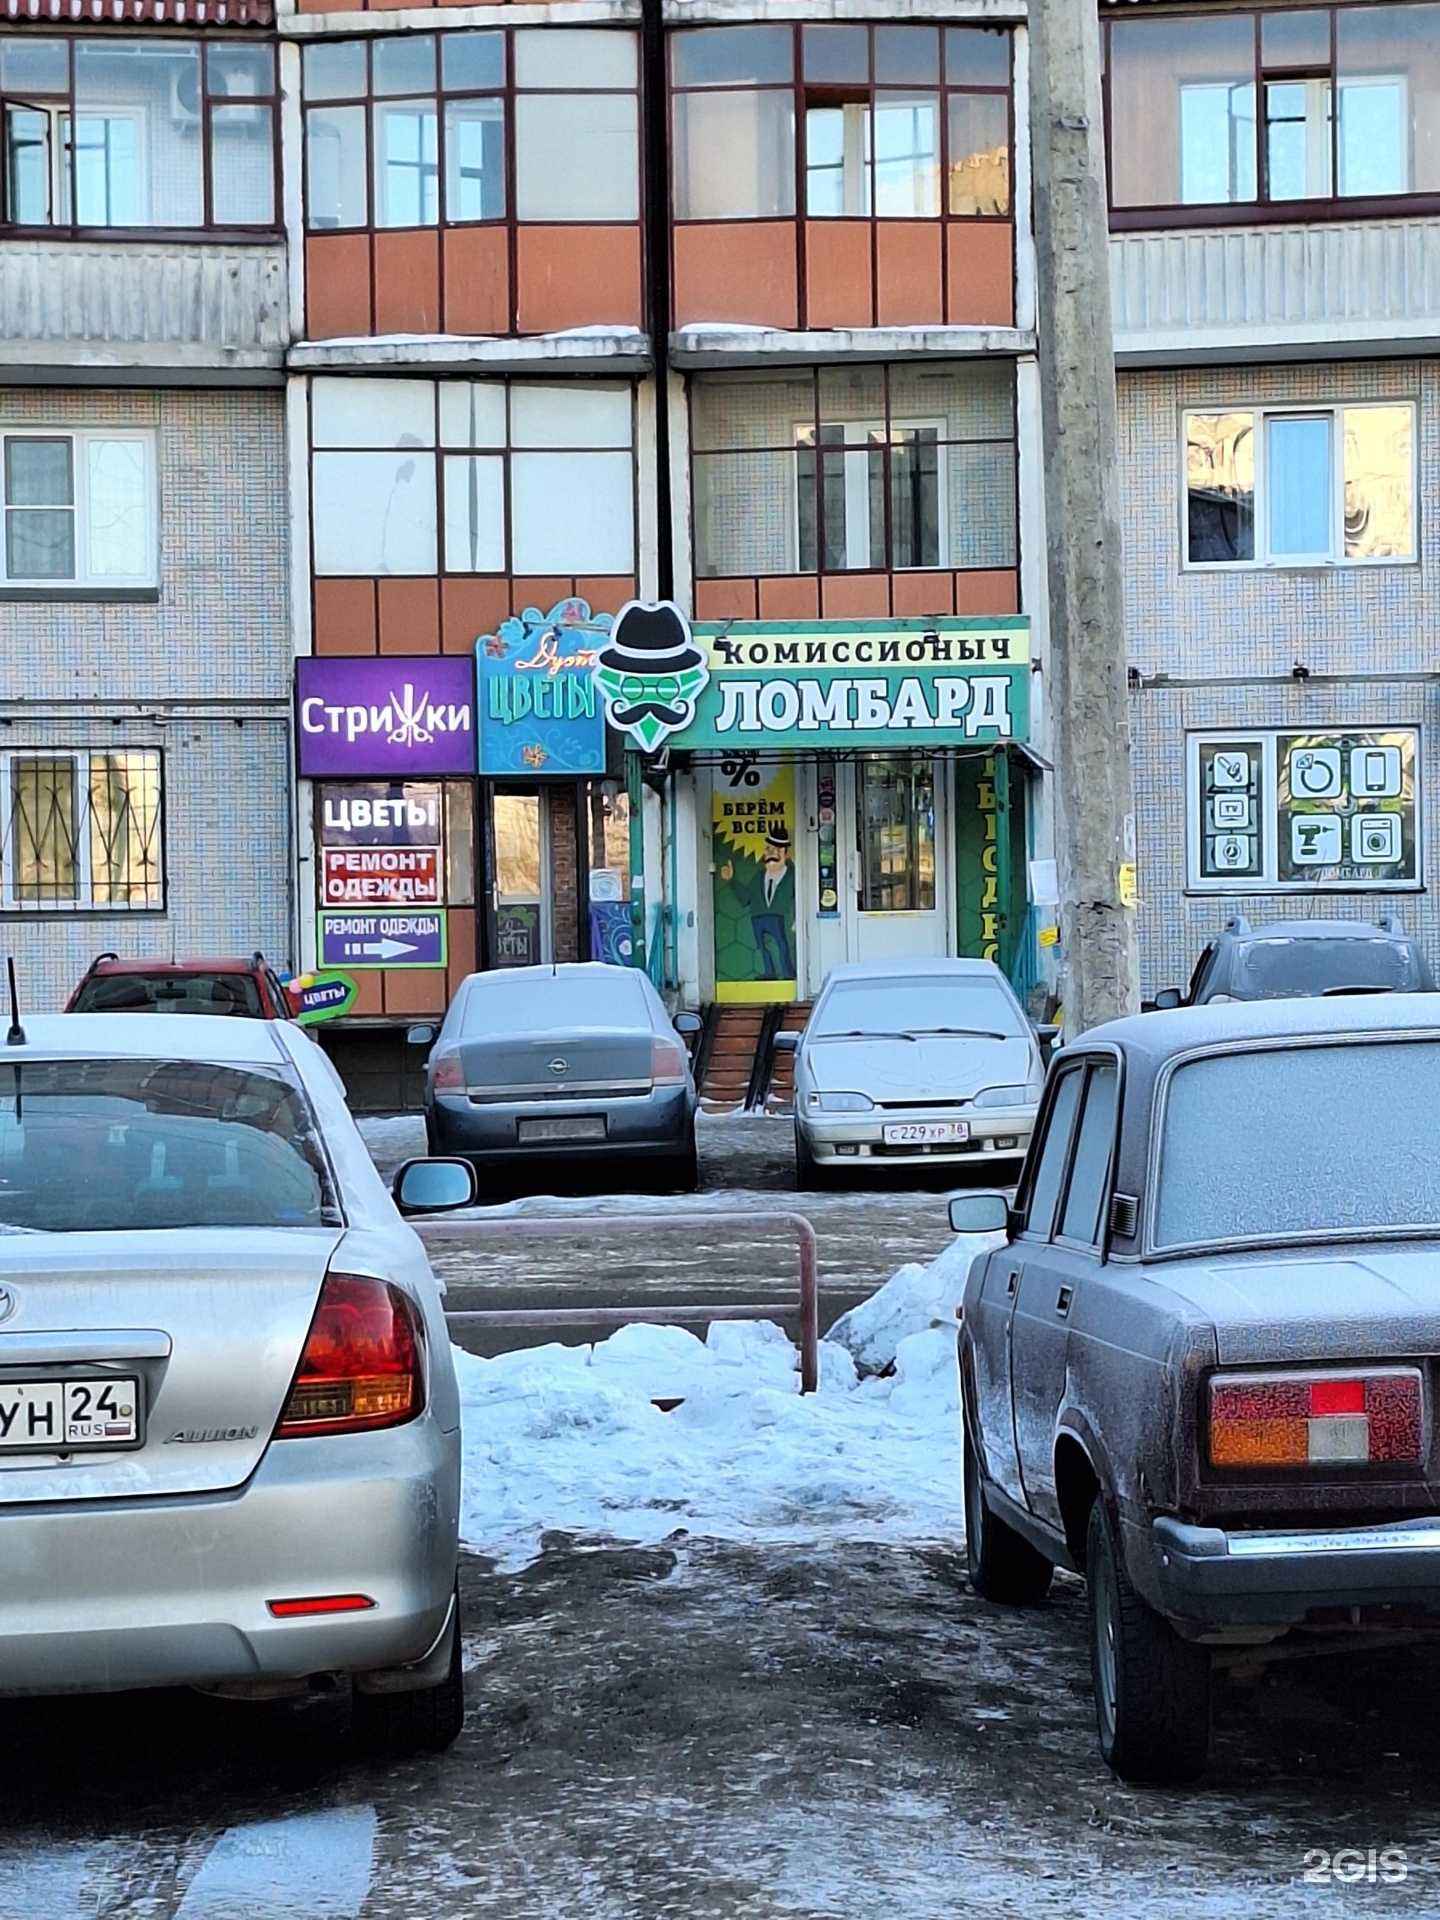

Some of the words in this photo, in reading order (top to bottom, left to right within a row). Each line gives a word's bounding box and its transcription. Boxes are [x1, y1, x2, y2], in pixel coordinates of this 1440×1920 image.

[489, 673, 596, 725] ЦВЕТЫ
[716, 675, 1012, 737] ЛОМБАРД
[324, 799, 436, 832] ЦВЕТЫ
[723, 799, 785, 816] БЕРЁМ
[330, 853, 432, 871] РЕМОНТ
[328, 878, 436, 900] ОДЕЖДЫ
[325, 918, 377, 935] РЕМОНТ
[380, 917, 438, 936] ОДЕЖДЫ
[71, 1386, 118, 1421] 24
[69, 1424, 103, 1436] RUS
